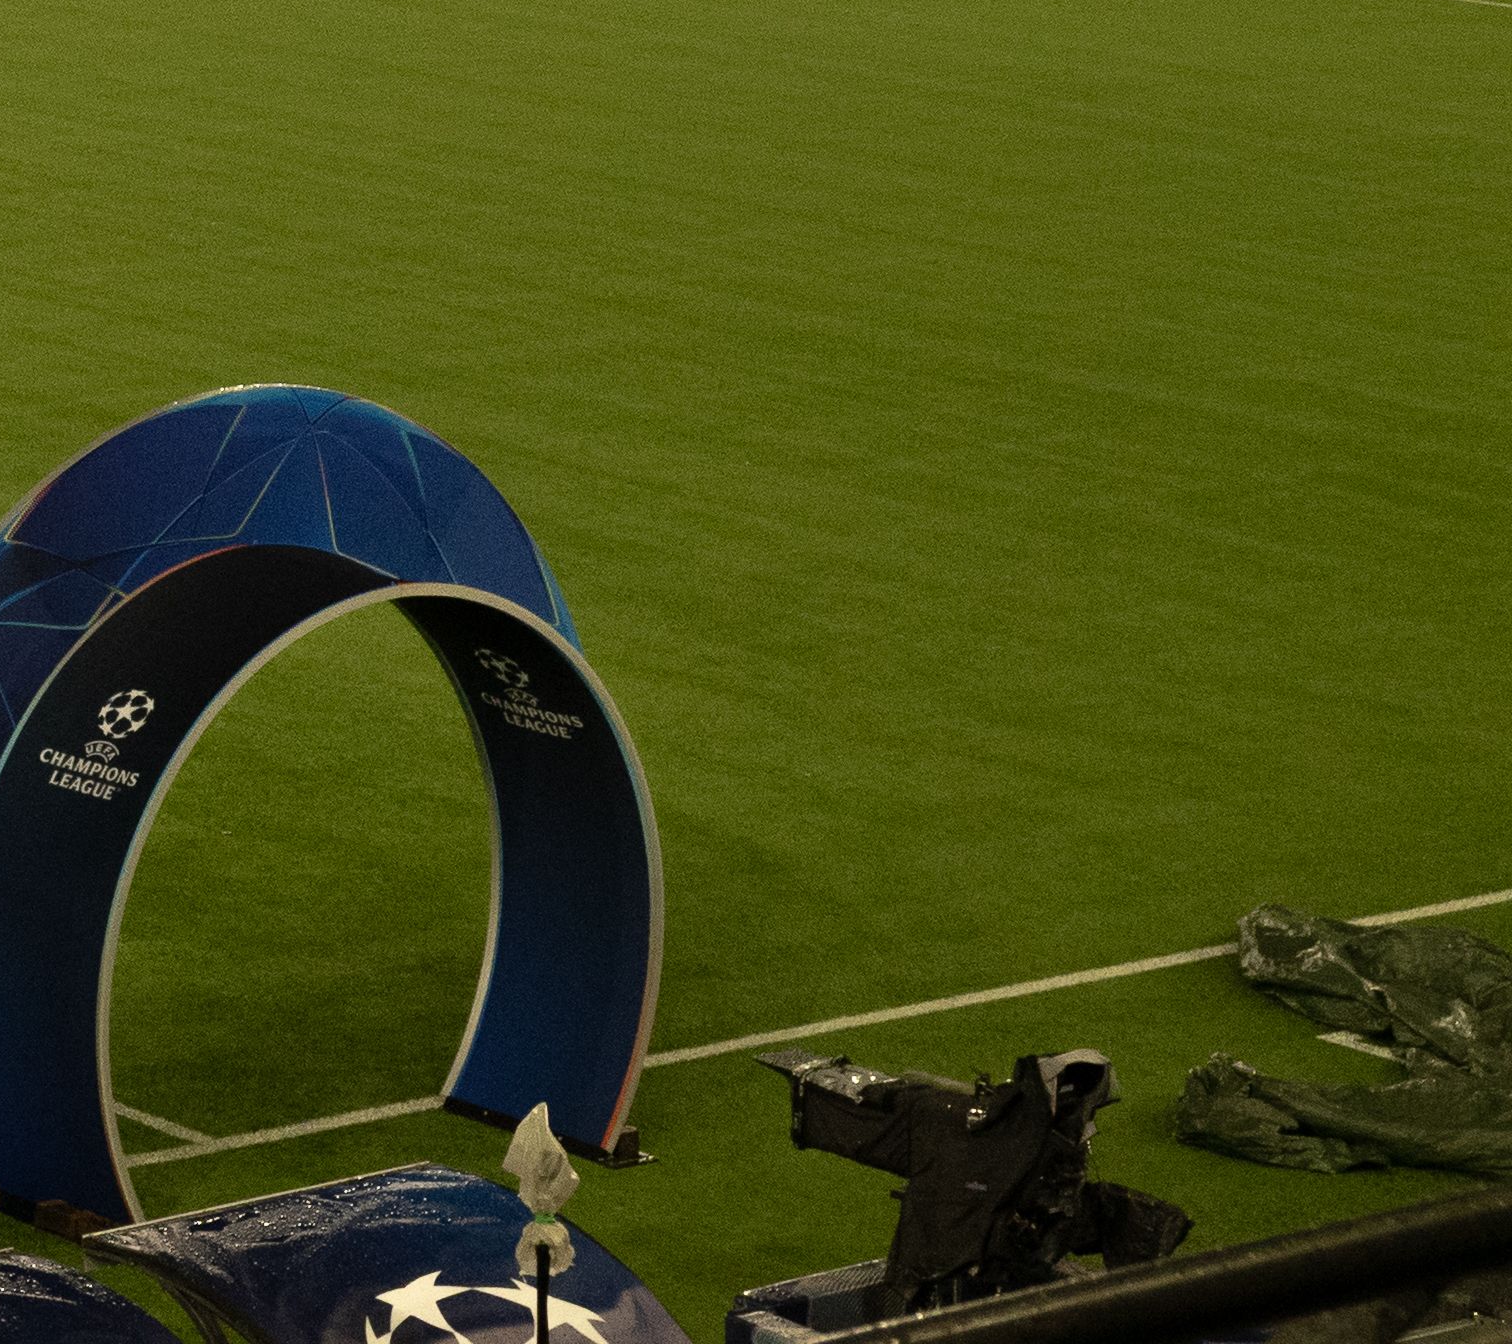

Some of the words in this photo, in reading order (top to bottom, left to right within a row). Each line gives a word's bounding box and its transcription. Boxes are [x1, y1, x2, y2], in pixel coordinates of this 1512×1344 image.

[504, 711, 572, 739] LEAGUE
[85, 743, 116, 761] UEFA
[40, 748, 140, 787] CHAMPIONS
[49, 770, 116, 800] LEAGUE
